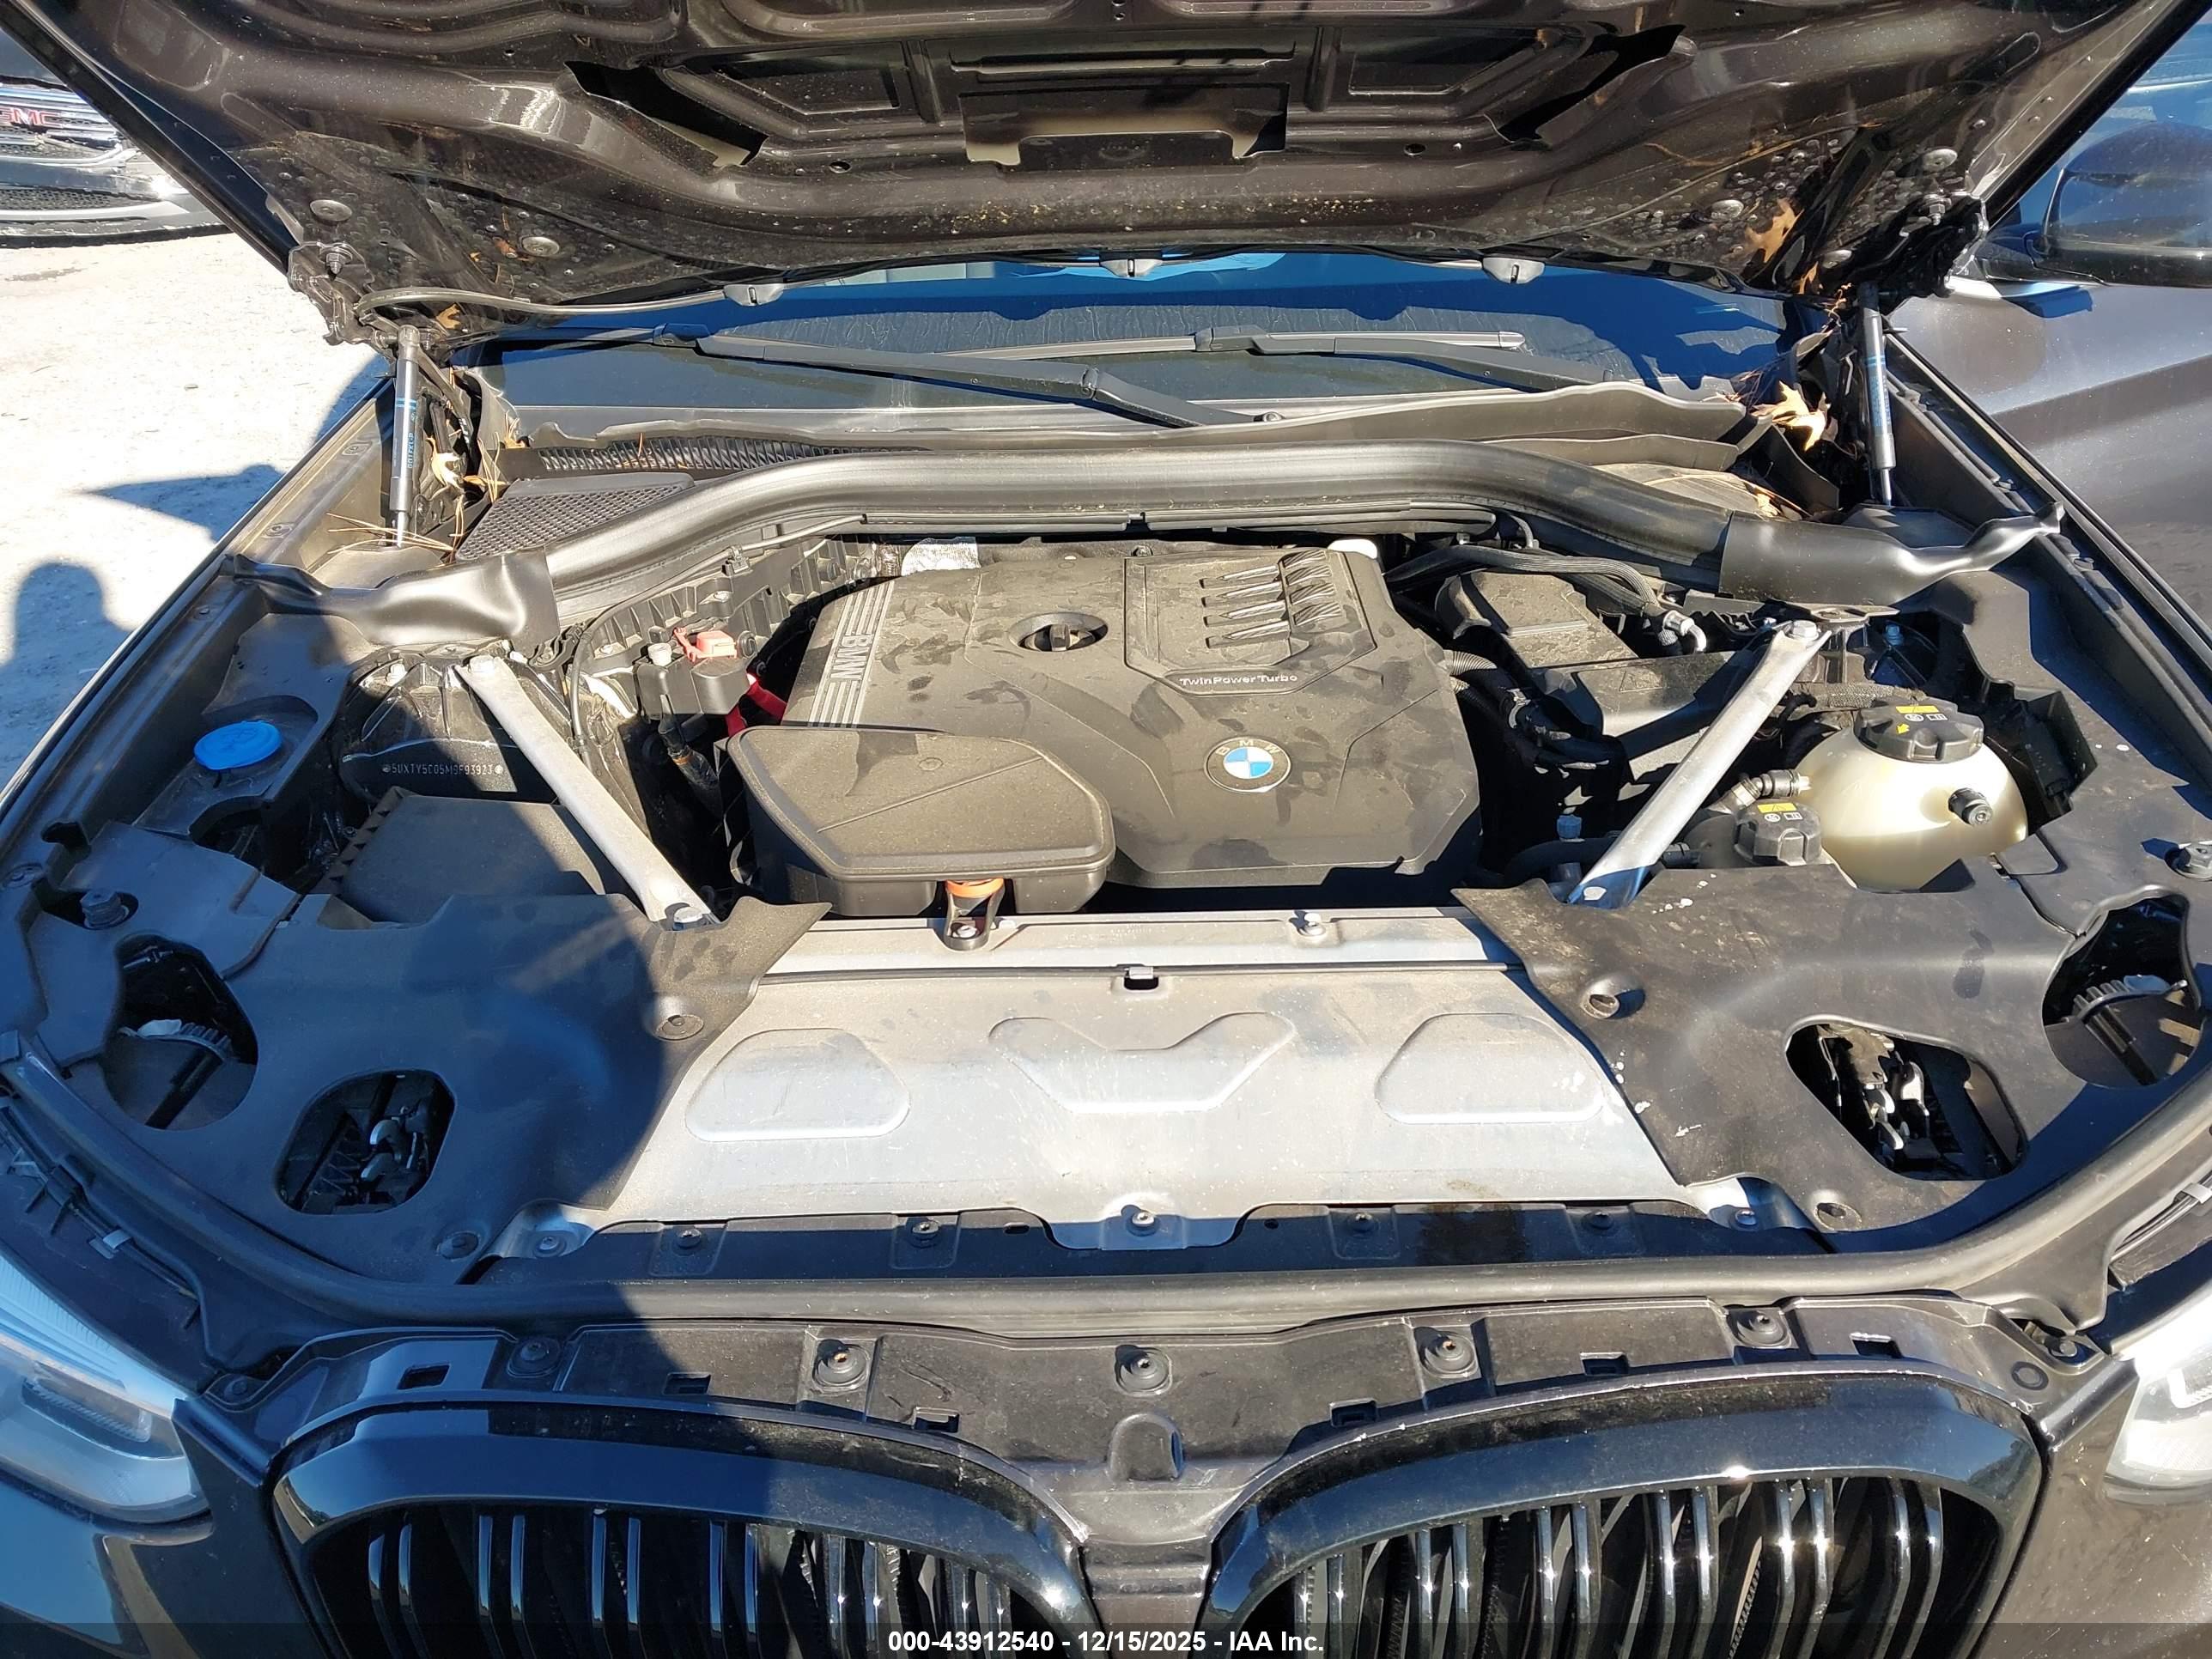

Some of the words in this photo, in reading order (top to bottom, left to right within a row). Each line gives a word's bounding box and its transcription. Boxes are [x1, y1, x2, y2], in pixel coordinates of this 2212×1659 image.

[830, 633, 874, 679] BMW
[1179, 676, 1256, 686] TwinPower
[1257, 674, 1298, 683] Turbo
[1206, 739, 1280, 756] BMW
